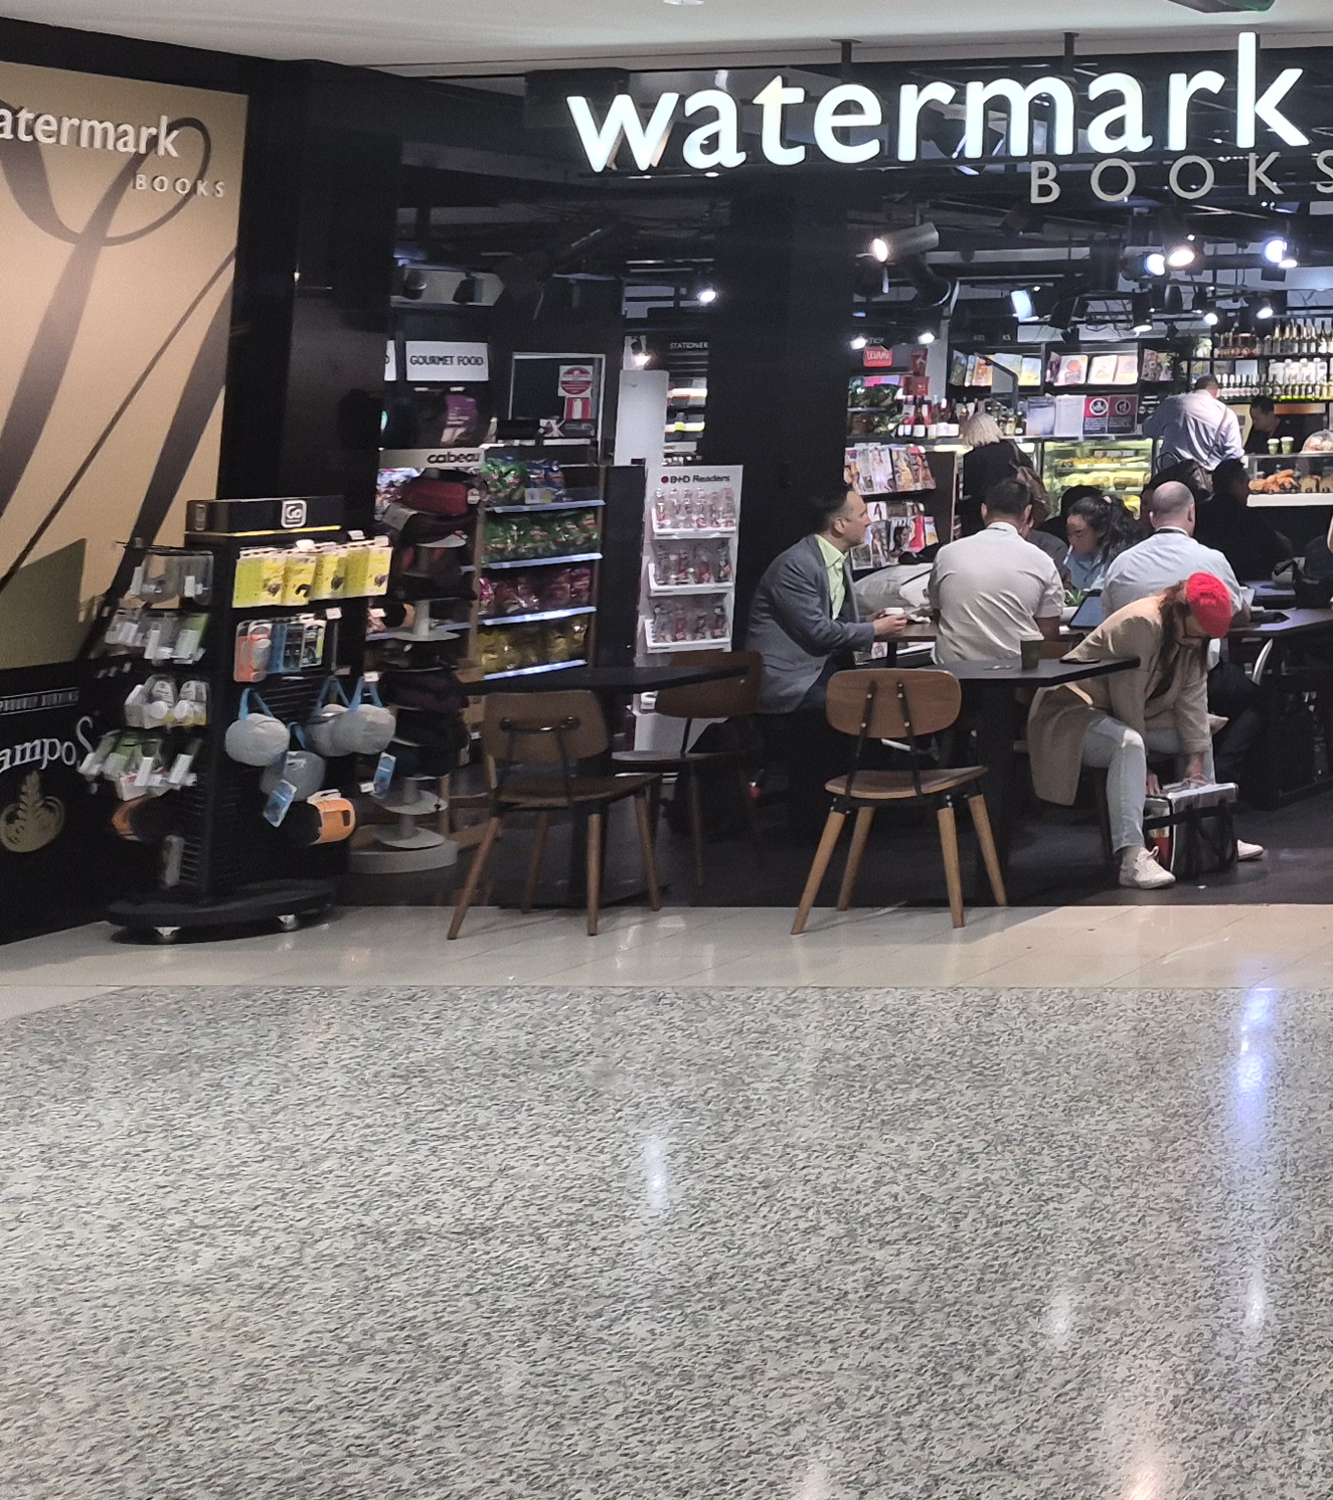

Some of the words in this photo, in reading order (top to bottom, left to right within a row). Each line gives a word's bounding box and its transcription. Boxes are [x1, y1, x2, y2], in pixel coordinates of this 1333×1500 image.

[567, 31, 1311, 174] watermark
[0, 106, 181, 158] atermark
[134, 173, 226, 199] BOOKS
[409, 355, 455, 366] GOURMET
[457, 356, 484, 367] FOOD
[427, 451, 481, 465] cabeau
[670, 475, 691, 484] B+D
[692, 474, 730, 483] Readers
[0, 716, 94, 775] ampoS
